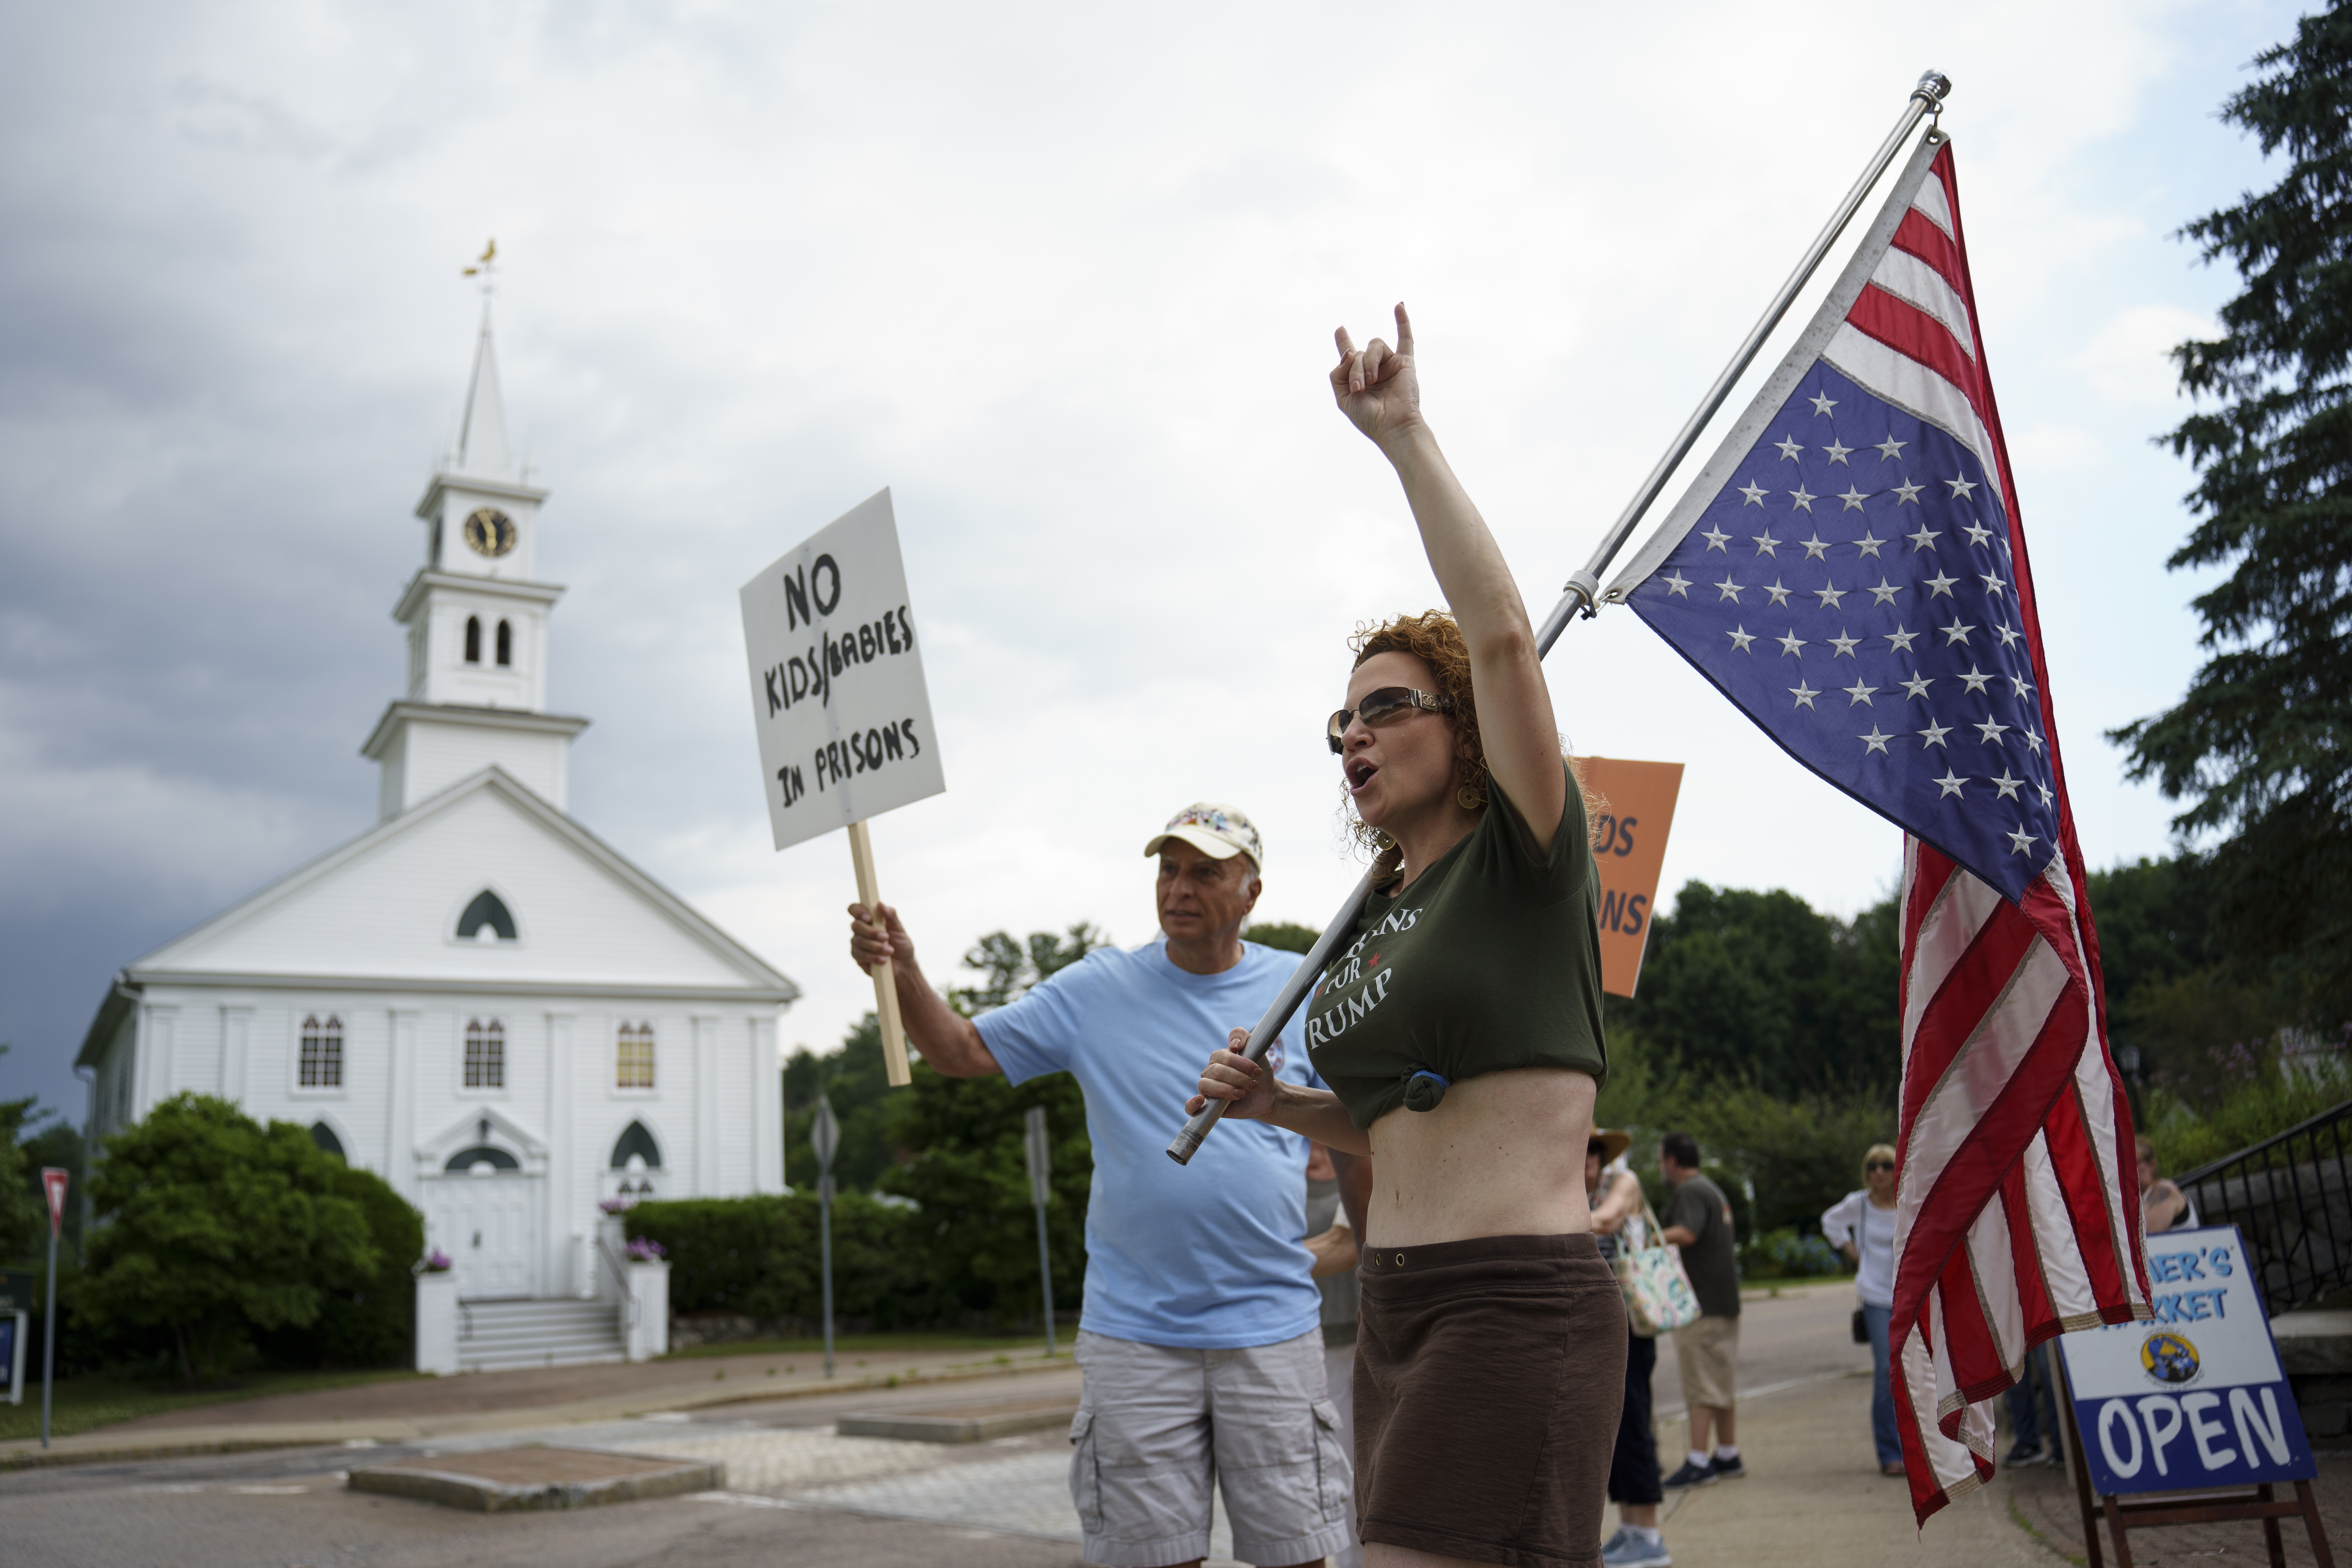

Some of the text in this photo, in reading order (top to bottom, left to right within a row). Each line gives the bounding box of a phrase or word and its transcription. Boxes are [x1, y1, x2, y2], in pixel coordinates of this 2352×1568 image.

[784, 554, 841, 632] NO
[764, 605, 913, 719] KIDS/BABIES
[777, 717, 920, 808] IN PRISONS
[1592, 814, 1637, 857] DS
[1305, 967, 1392, 1050] RUMP
[2098, 1388, 2290, 1479] OPEN
